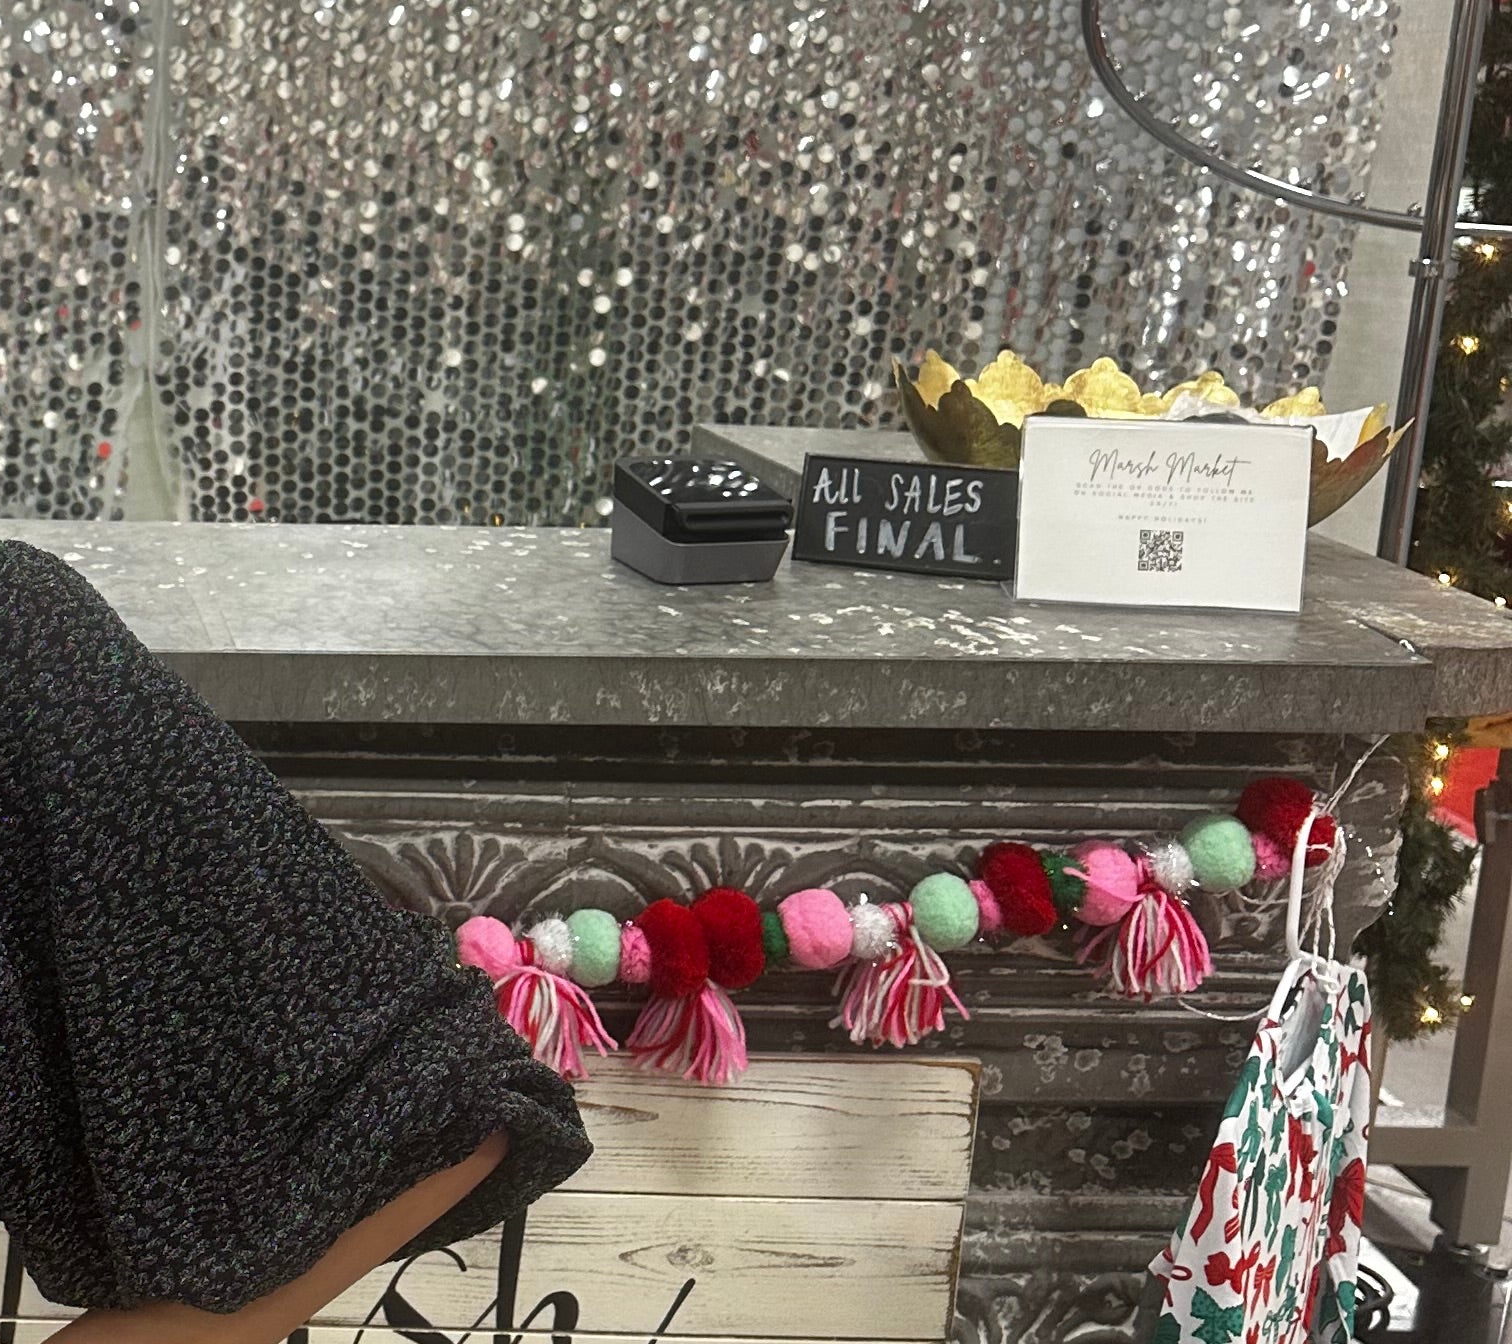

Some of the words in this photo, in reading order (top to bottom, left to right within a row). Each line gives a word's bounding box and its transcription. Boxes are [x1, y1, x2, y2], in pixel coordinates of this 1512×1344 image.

[1089, 448, 1159, 482] Marsh
[1165, 451, 1252, 487] Market
[884, 473, 984, 516] SALES
